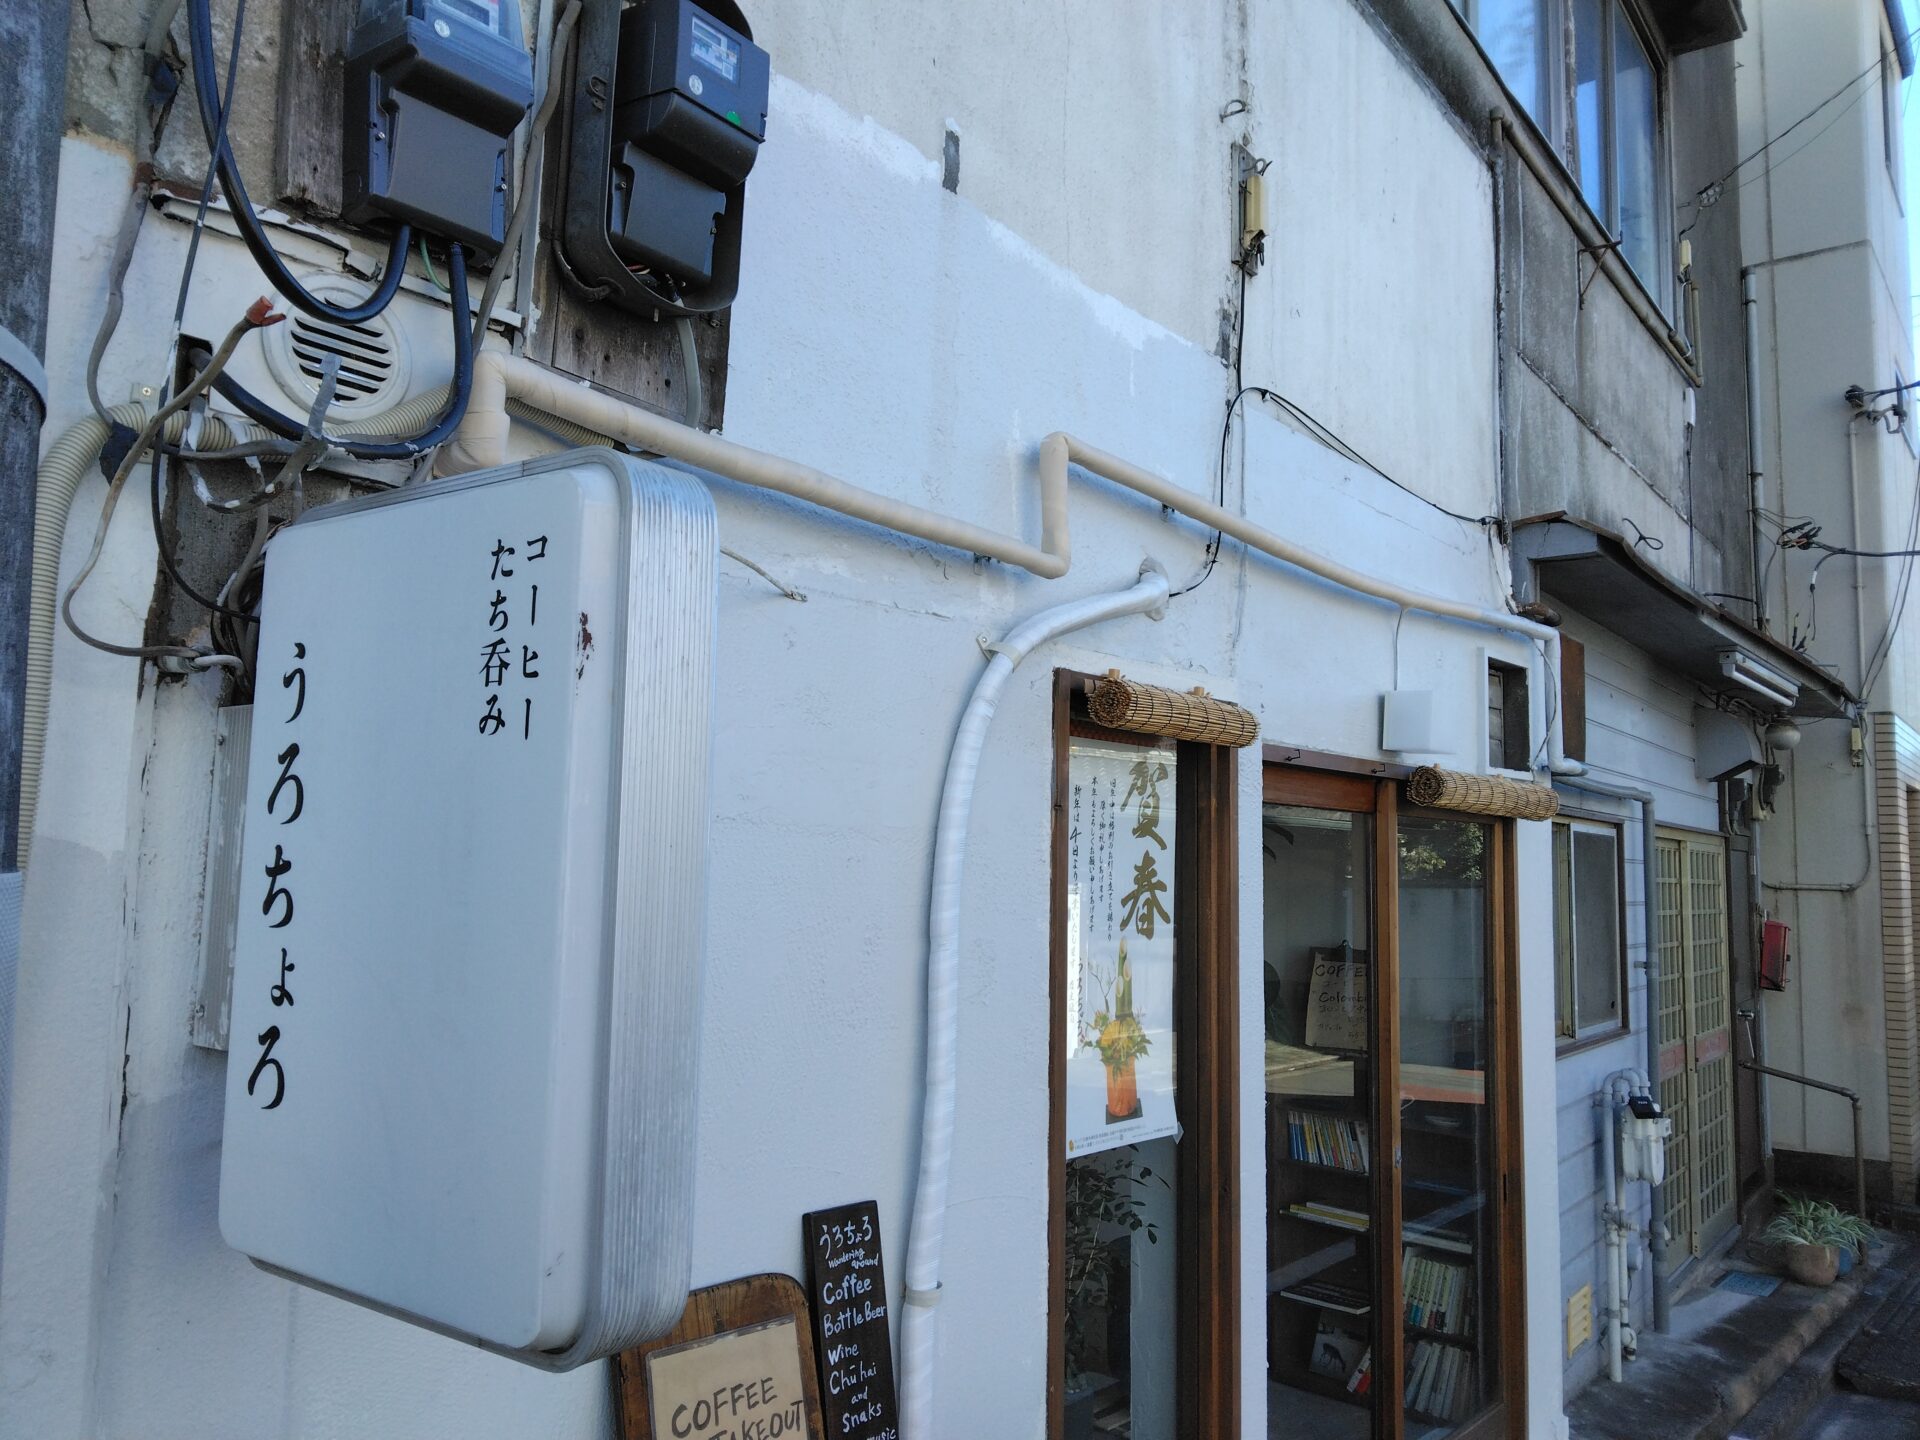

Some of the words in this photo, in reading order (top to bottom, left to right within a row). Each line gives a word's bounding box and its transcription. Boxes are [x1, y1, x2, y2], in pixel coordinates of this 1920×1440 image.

[478, 538, 515, 736] たち呑み
[521, 534, 549, 741] コーヒー
[1120, 757, 1171, 941] 賀春
[247, 642, 306, 1110] うろちょろ
[1315, 963, 1367, 978] COFFE
[819, 1215, 873, 1260] うろちょろ
[823, 1273, 872, 1305] Coffee
[823, 1307, 864, 1338] Bottle
[864, 1300, 887, 1321] Beer
[828, 1344, 859, 1367] Wine
[672, 1377, 778, 1439] COFFEE
[850, 1385, 868, 1404] and
[708, 1399, 803, 1440] KEOUT
[842, 1402, 882, 1433] Snaks
